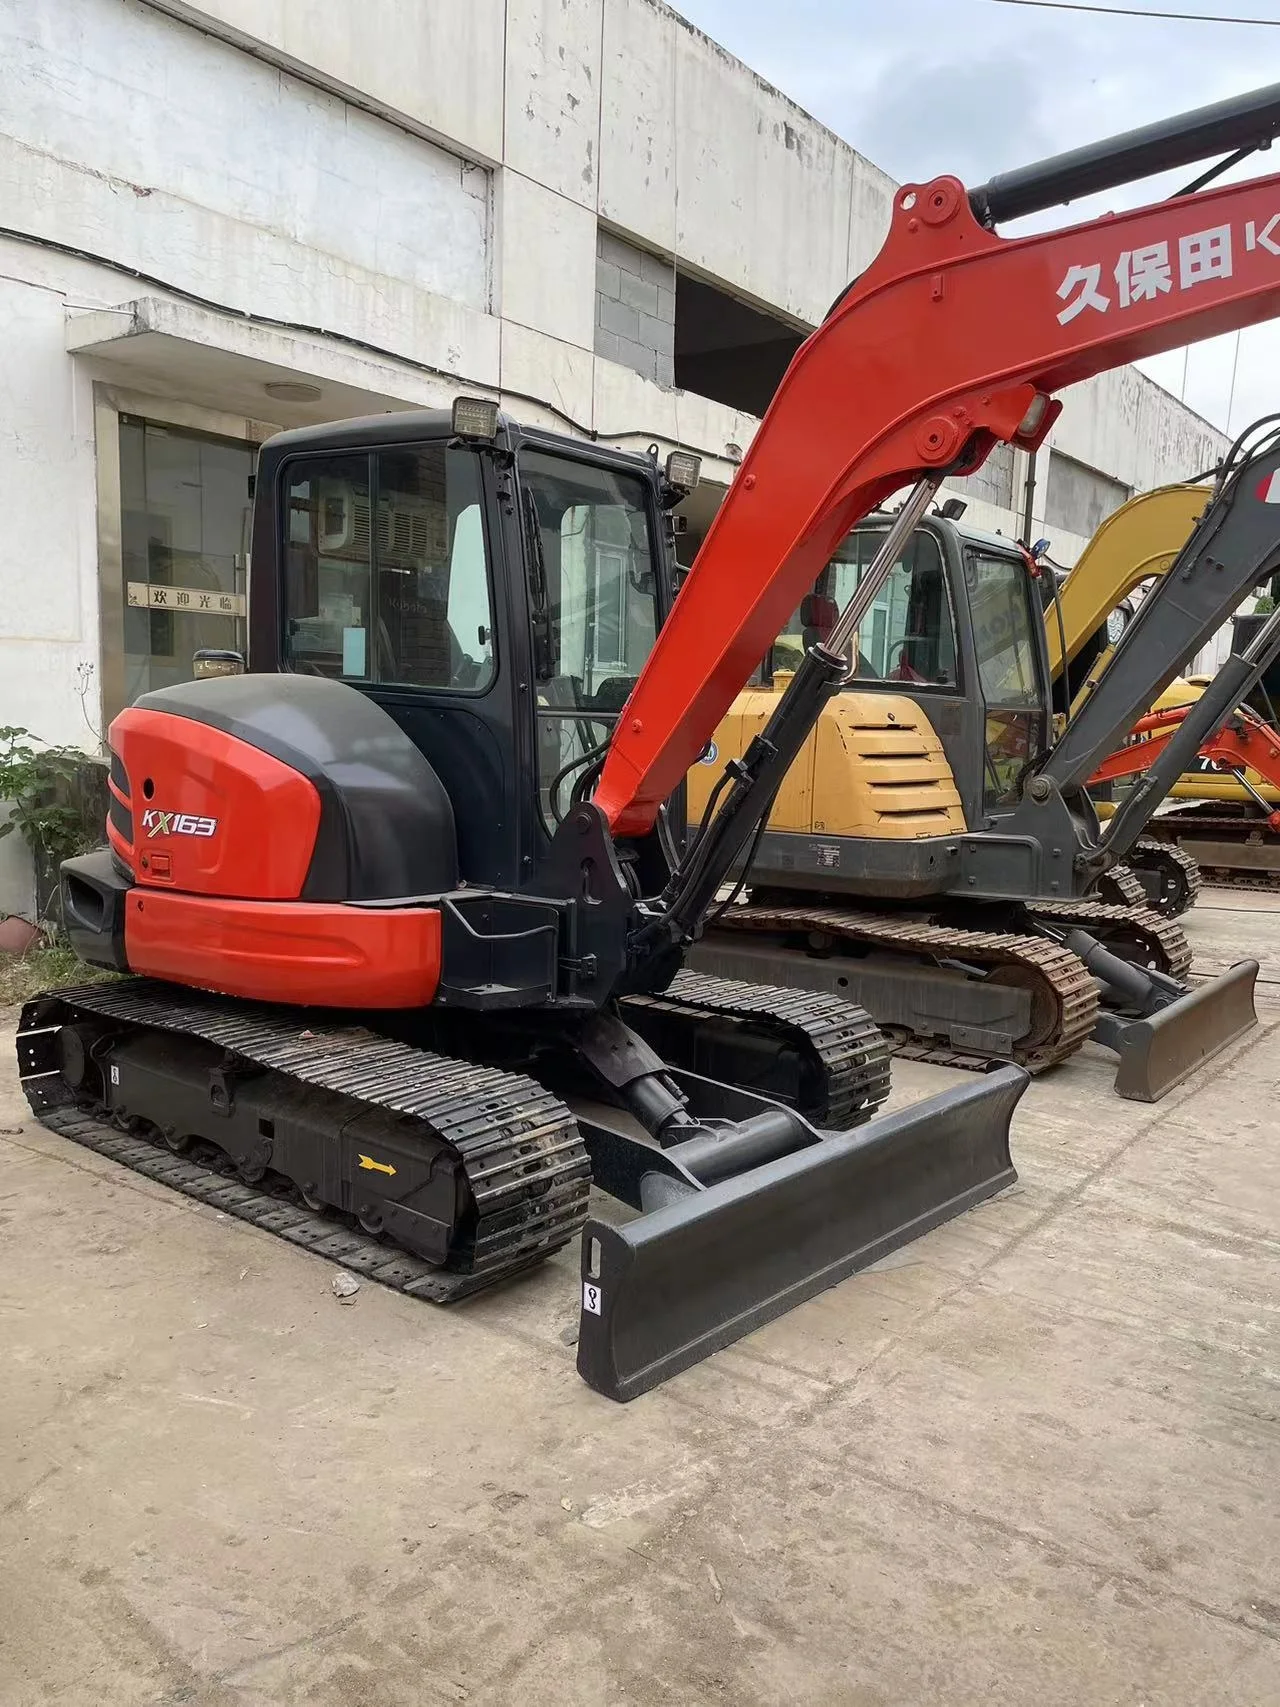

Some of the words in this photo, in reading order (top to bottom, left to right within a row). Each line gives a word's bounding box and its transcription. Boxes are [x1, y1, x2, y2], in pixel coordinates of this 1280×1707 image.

[1055, 223, 1233, 326] 久保田
[153, 590, 232, 610] 欢迎光临
[142, 809, 217, 838] KX163
